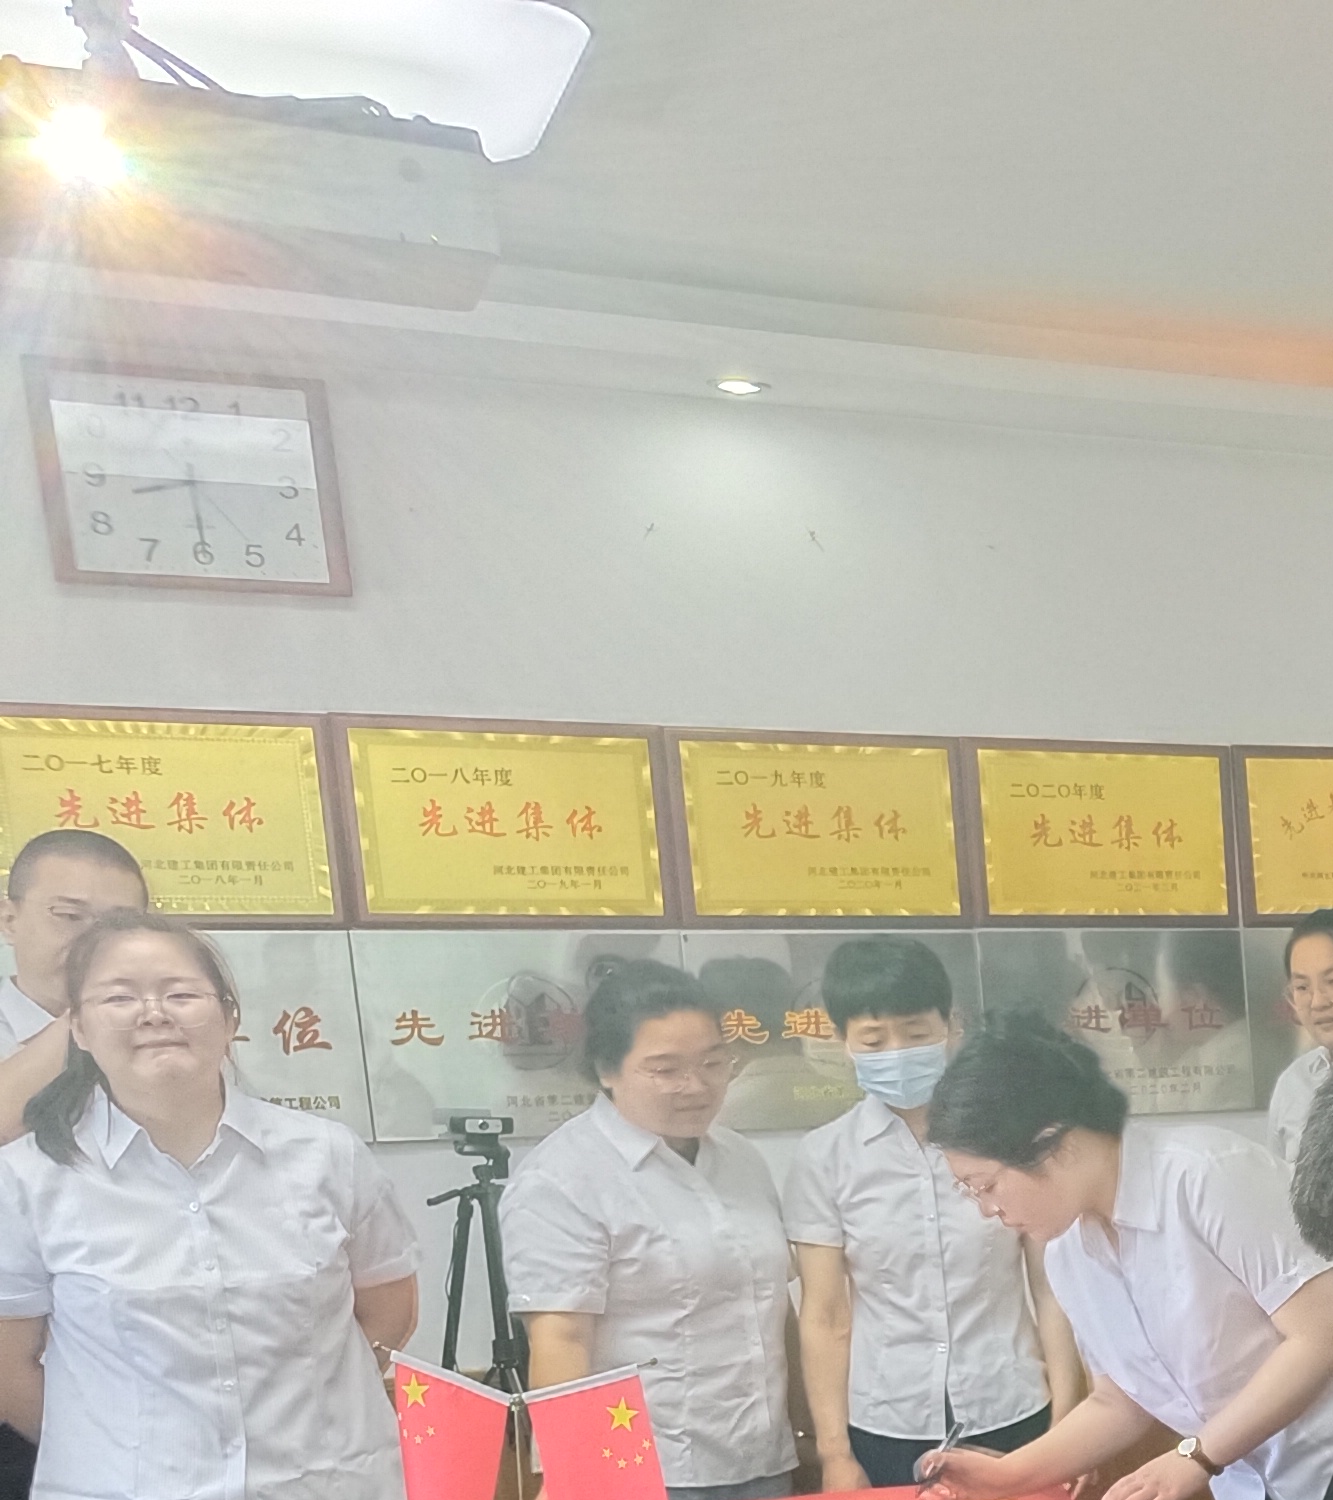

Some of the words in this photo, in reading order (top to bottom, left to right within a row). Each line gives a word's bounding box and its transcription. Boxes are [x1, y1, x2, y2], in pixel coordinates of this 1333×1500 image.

[83, 462, 106, 487] 9
[278, 476, 299, 499] 3
[90, 511, 114, 536] 8
[286, 523, 305, 547] 4
[138, 538, 161, 563] 7
[194, 541, 215, 566] 6
[244, 545, 266, 568] 5
[54, 788, 266, 836] 先进集体
[418, 798, 605, 843] 先进集体
[740, 802, 909, 844] 先进集体
[1029, 812, 1184, 851] 先进集体
[721, 1008, 834, 1045] 先进
